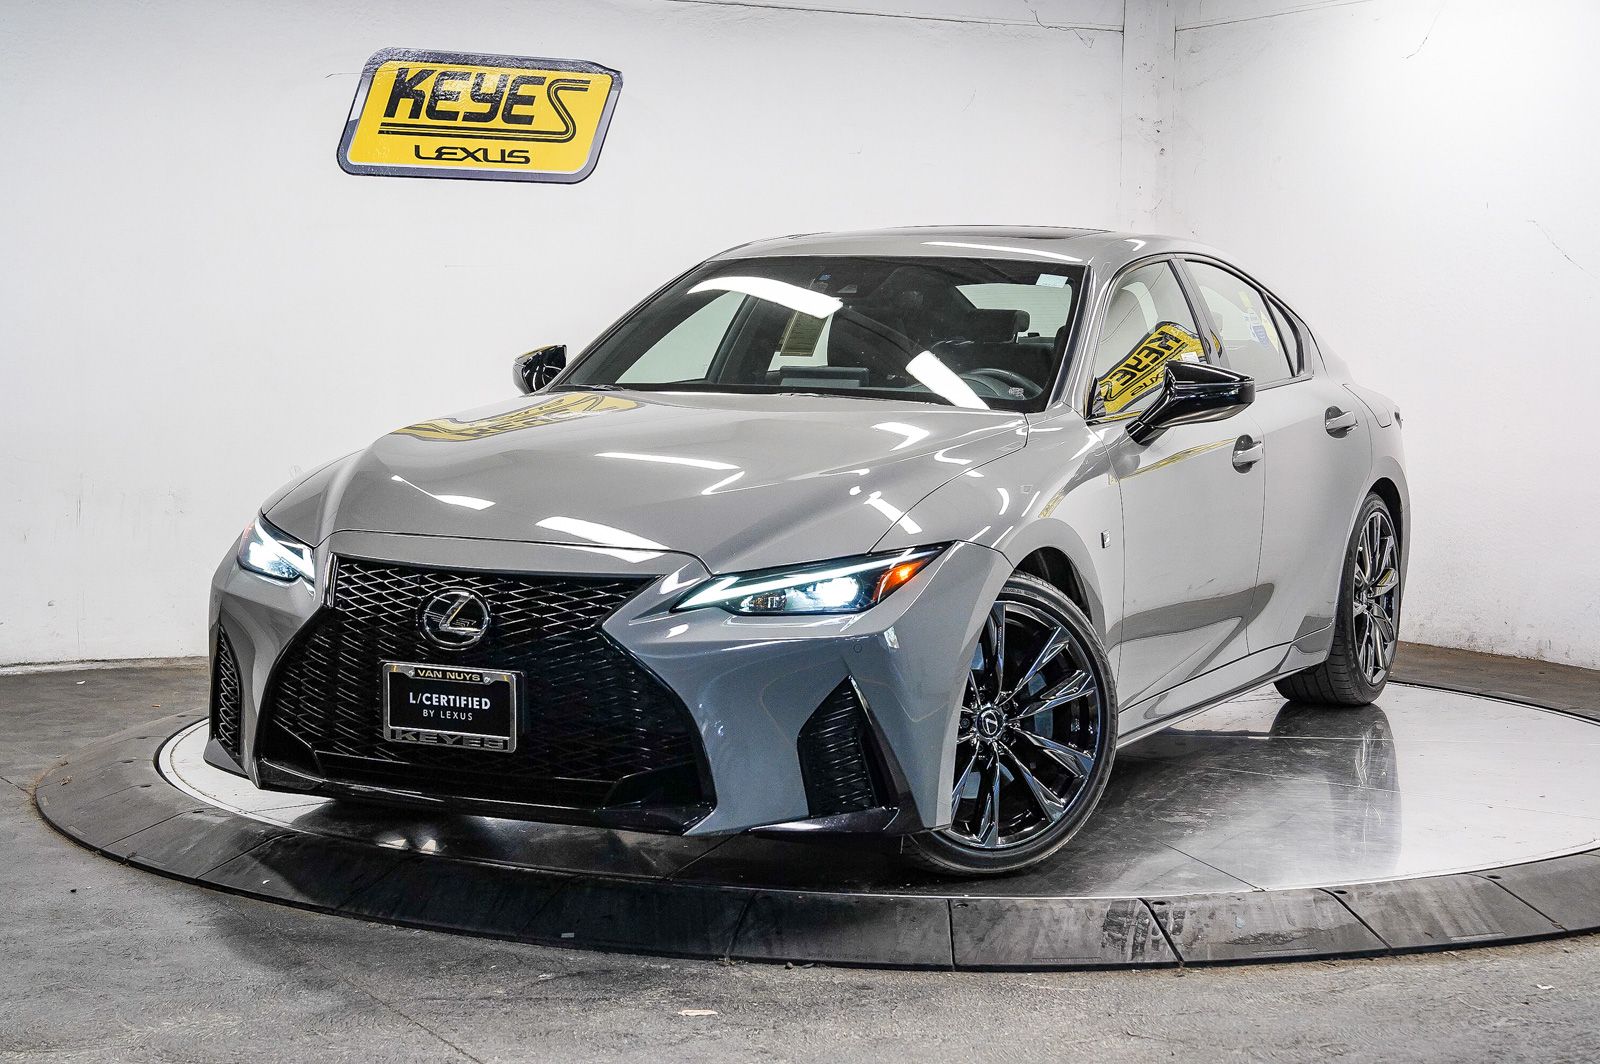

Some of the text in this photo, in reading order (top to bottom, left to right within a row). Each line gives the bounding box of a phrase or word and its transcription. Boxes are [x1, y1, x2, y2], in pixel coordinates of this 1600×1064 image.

[378, 67, 590, 143] KEYES
[414, 144, 531, 164] LEXUS
[417, 669, 481, 682] VAN NUYS
[409, 692, 491, 710] L/CERTIFIED
[422, 709, 473, 721] BY LEXUS
[394, 729, 504, 750] KEYES
